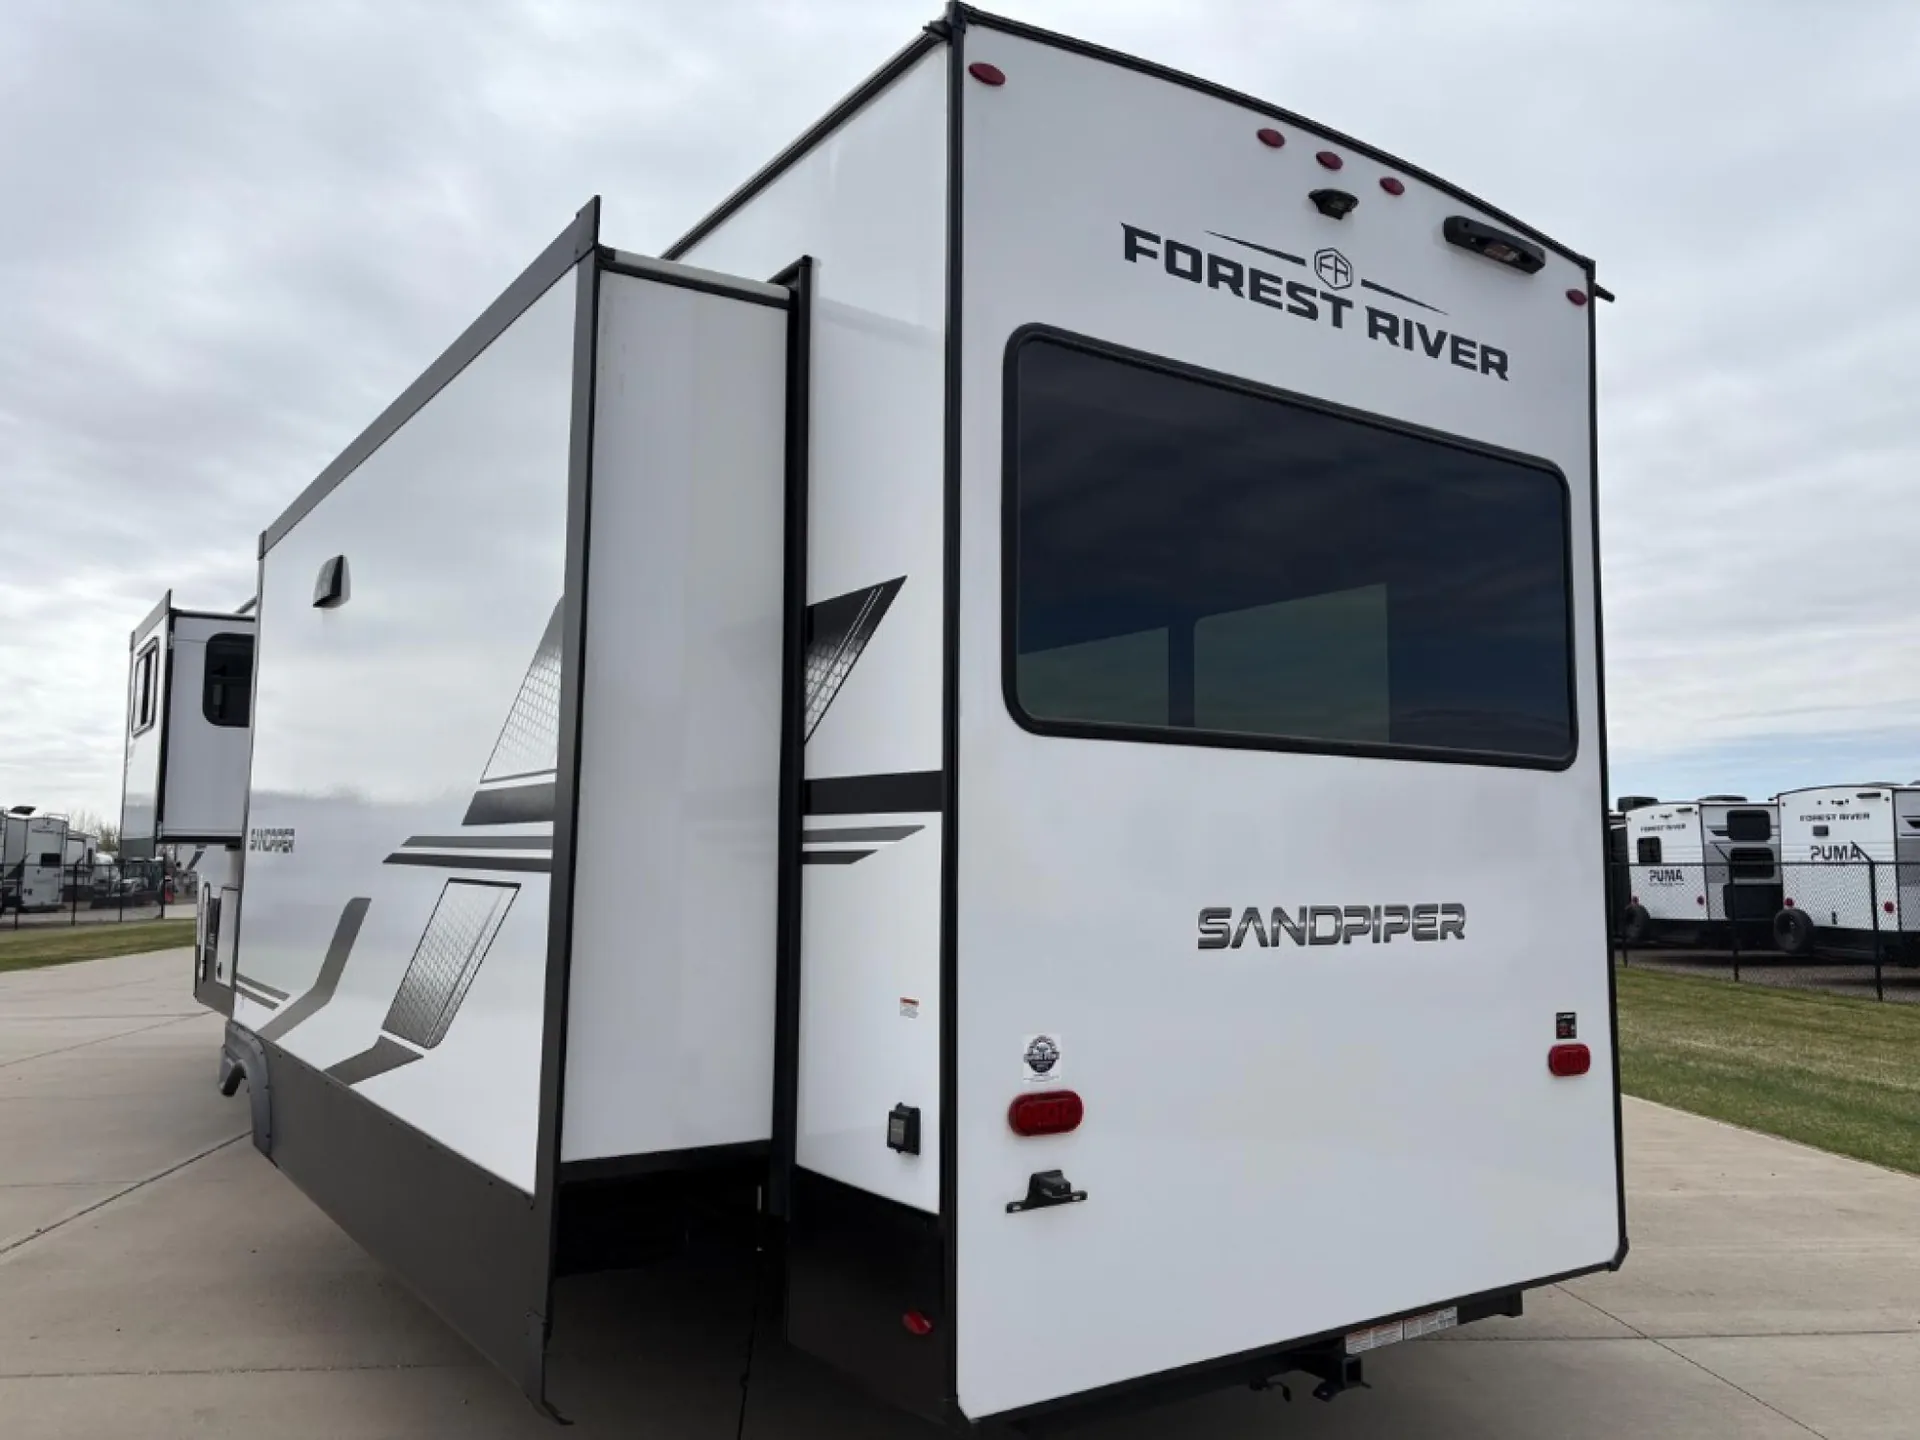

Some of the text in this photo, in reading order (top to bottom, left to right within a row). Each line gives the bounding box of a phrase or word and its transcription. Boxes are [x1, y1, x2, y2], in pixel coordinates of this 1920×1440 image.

[1121, 222, 1509, 381] FOREST RIVER
[1810, 845, 1861, 861] PUMA
[1649, 869, 1684, 882] PUMA
[1198, 903, 1466, 949] SANDPIPER
